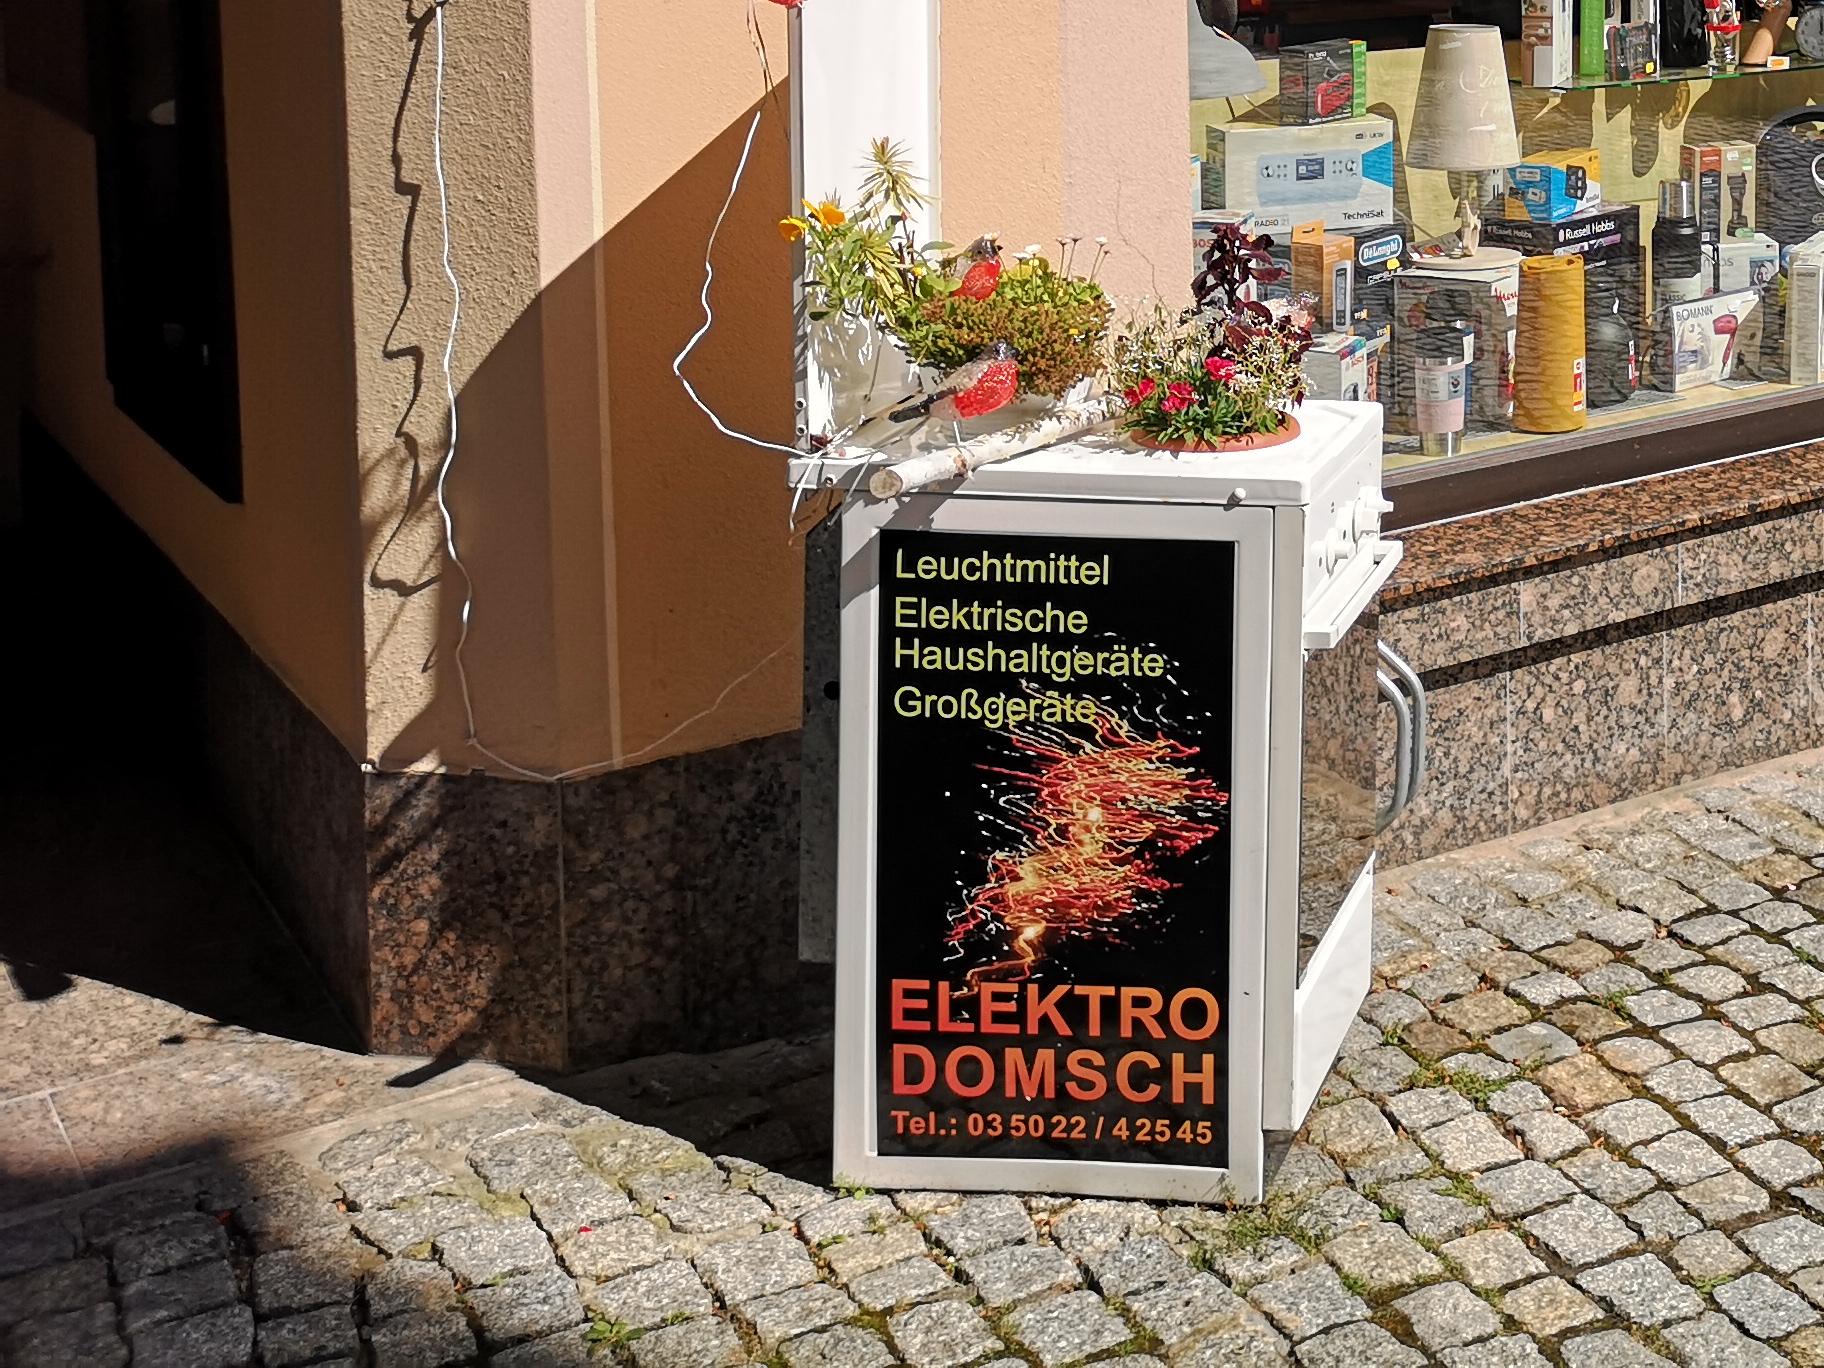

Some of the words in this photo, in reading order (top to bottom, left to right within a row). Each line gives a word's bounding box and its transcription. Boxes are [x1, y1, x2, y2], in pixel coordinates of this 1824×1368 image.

[1565, 225, 1591, 240] Russell
[1592, 219, 1615, 235] Hobbs
[1676, 305, 1714, 322] BOMANN
[894, 547, 1110, 587] Leuchtmittel
[893, 596, 1089, 634] Elektrische
[892, 638, 1166, 681] Haushaltgeräte
[892, 685, 1098, 729] Großgeräte
[890, 978, 1221, 1041] ELEKTRO
[890, 1043, 1216, 1105] DOMSCH
[890, 1110, 958, 1136] Tel.:
